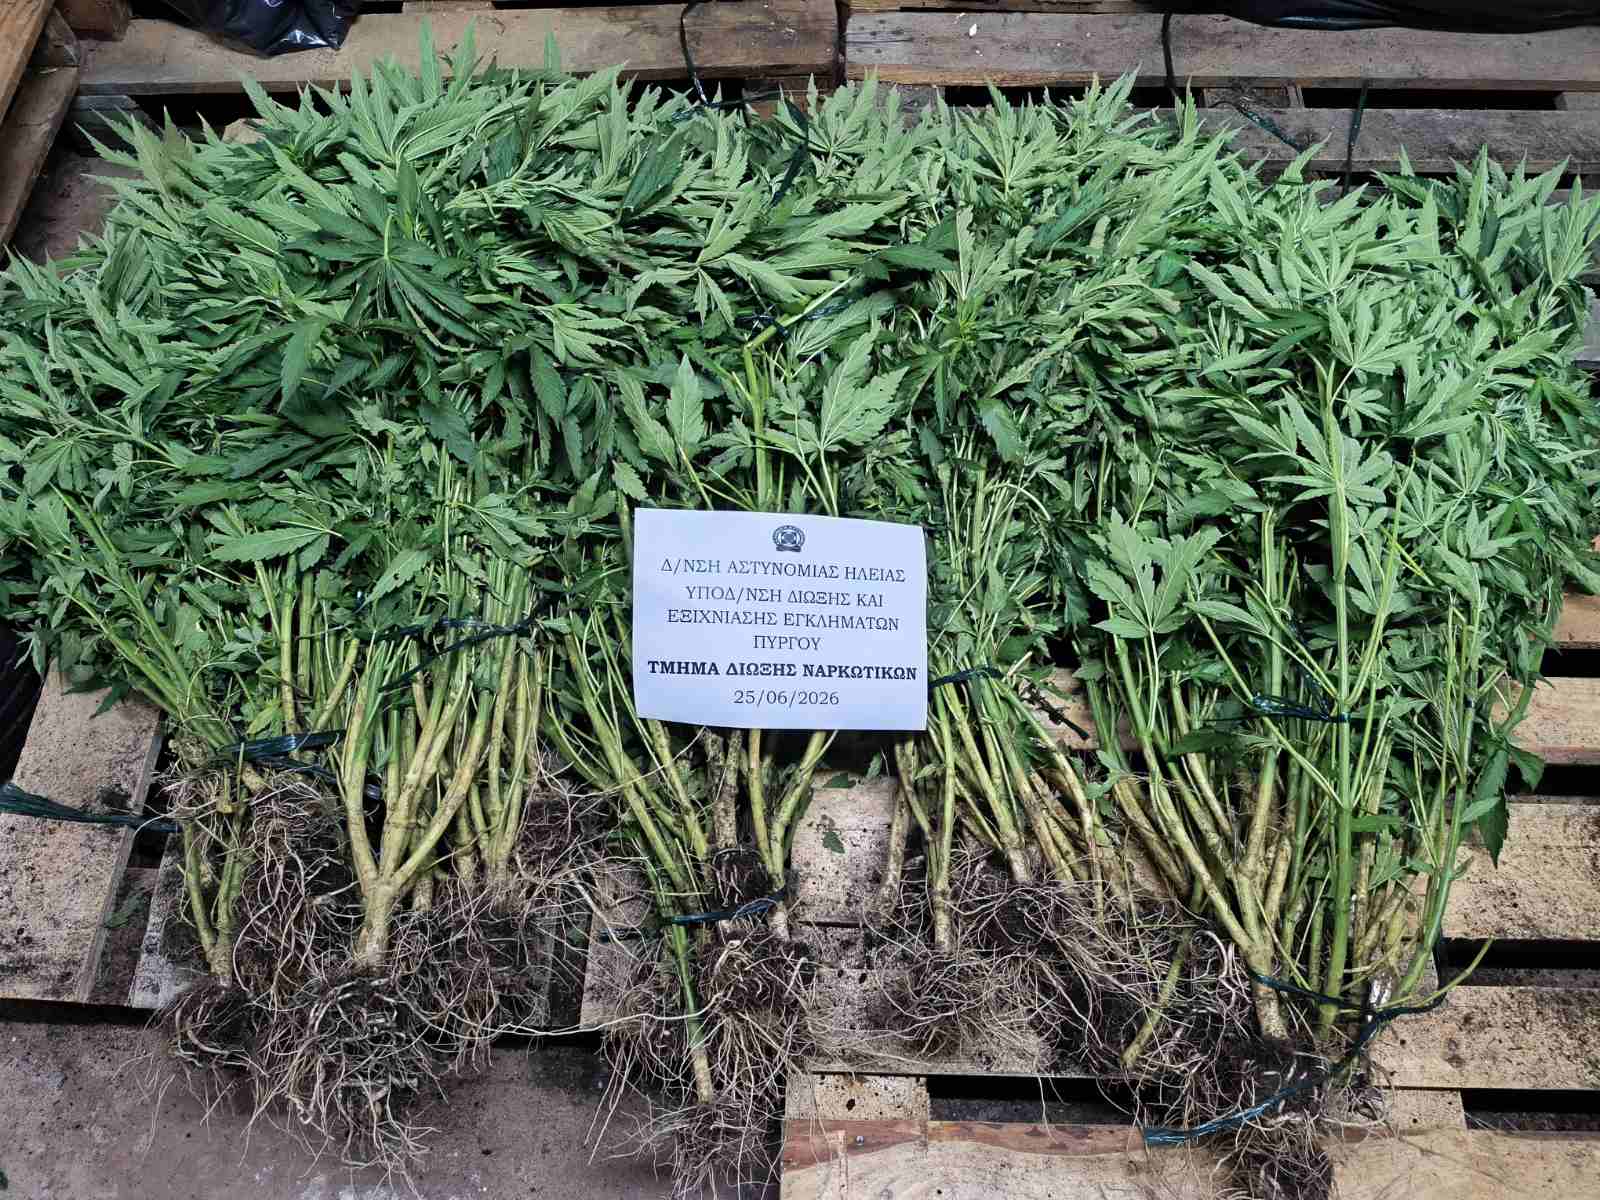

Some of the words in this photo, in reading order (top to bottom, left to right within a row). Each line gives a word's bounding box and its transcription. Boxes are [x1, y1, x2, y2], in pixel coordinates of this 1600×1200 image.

[660, 558, 720, 576] Δ/ΝΣΗ
[727, 560, 840, 579] ΑΣΤΥΝΟΜΙΑΣ
[844, 566, 906, 583] ΗΛΕΙΑΣ
[685, 585, 782, 605] ΥΠΟΔ/ΝΣΗ
[787, 590, 851, 606] ΔΙΩΞΗΣ
[857, 593, 883, 608] ΚΑΙ
[667, 608, 778, 626] ΕΞΙΧΝΙΑΣΗΣ
[783, 612, 899, 631] ΕΓΚΛΗΜΑΤΩΝ
[753, 635, 821, 651] ΠΥΡΓΟΥ
[647, 660, 721, 676] ΤΜΗΜΑ
[725, 662, 797, 677] ΔΙΩΞΗΣ
[802, 663, 918, 681] ΝΑΡΚΩΤΙΚΩΝ
[733, 689, 840, 708] 25/06/2026
